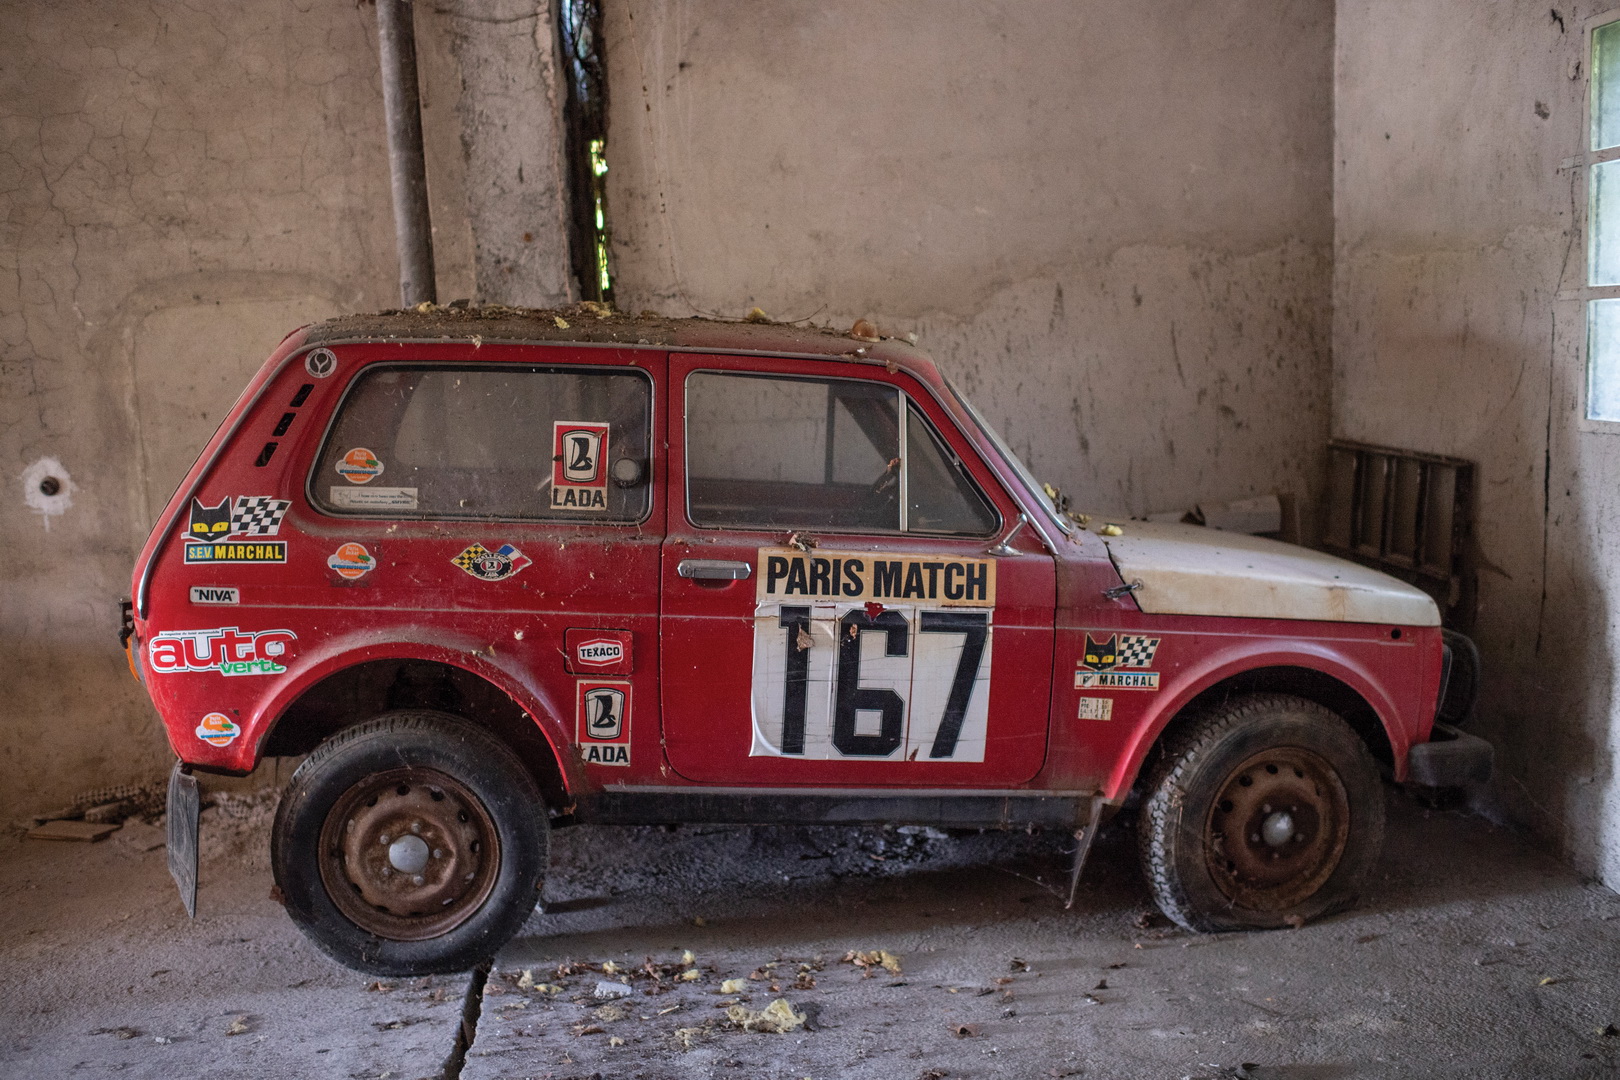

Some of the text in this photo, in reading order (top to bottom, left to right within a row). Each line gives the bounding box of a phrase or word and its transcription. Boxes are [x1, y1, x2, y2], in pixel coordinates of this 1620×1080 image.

[553, 488, 606, 508] LADA
[189, 545, 283, 560] S.E.V. MARCHAL
[766, 556, 988, 601] PARIS MATCH
[194, 589, 235, 602] "NIVA"
[152, 628, 294, 668] auto
[580, 646, 620, 658] TEXACO
[220, 659, 286, 674] verte
[779, 605, 989, 759] 167
[1099, 674, 1154, 687] MARCHAL
[588, 745, 629, 763] ADA
